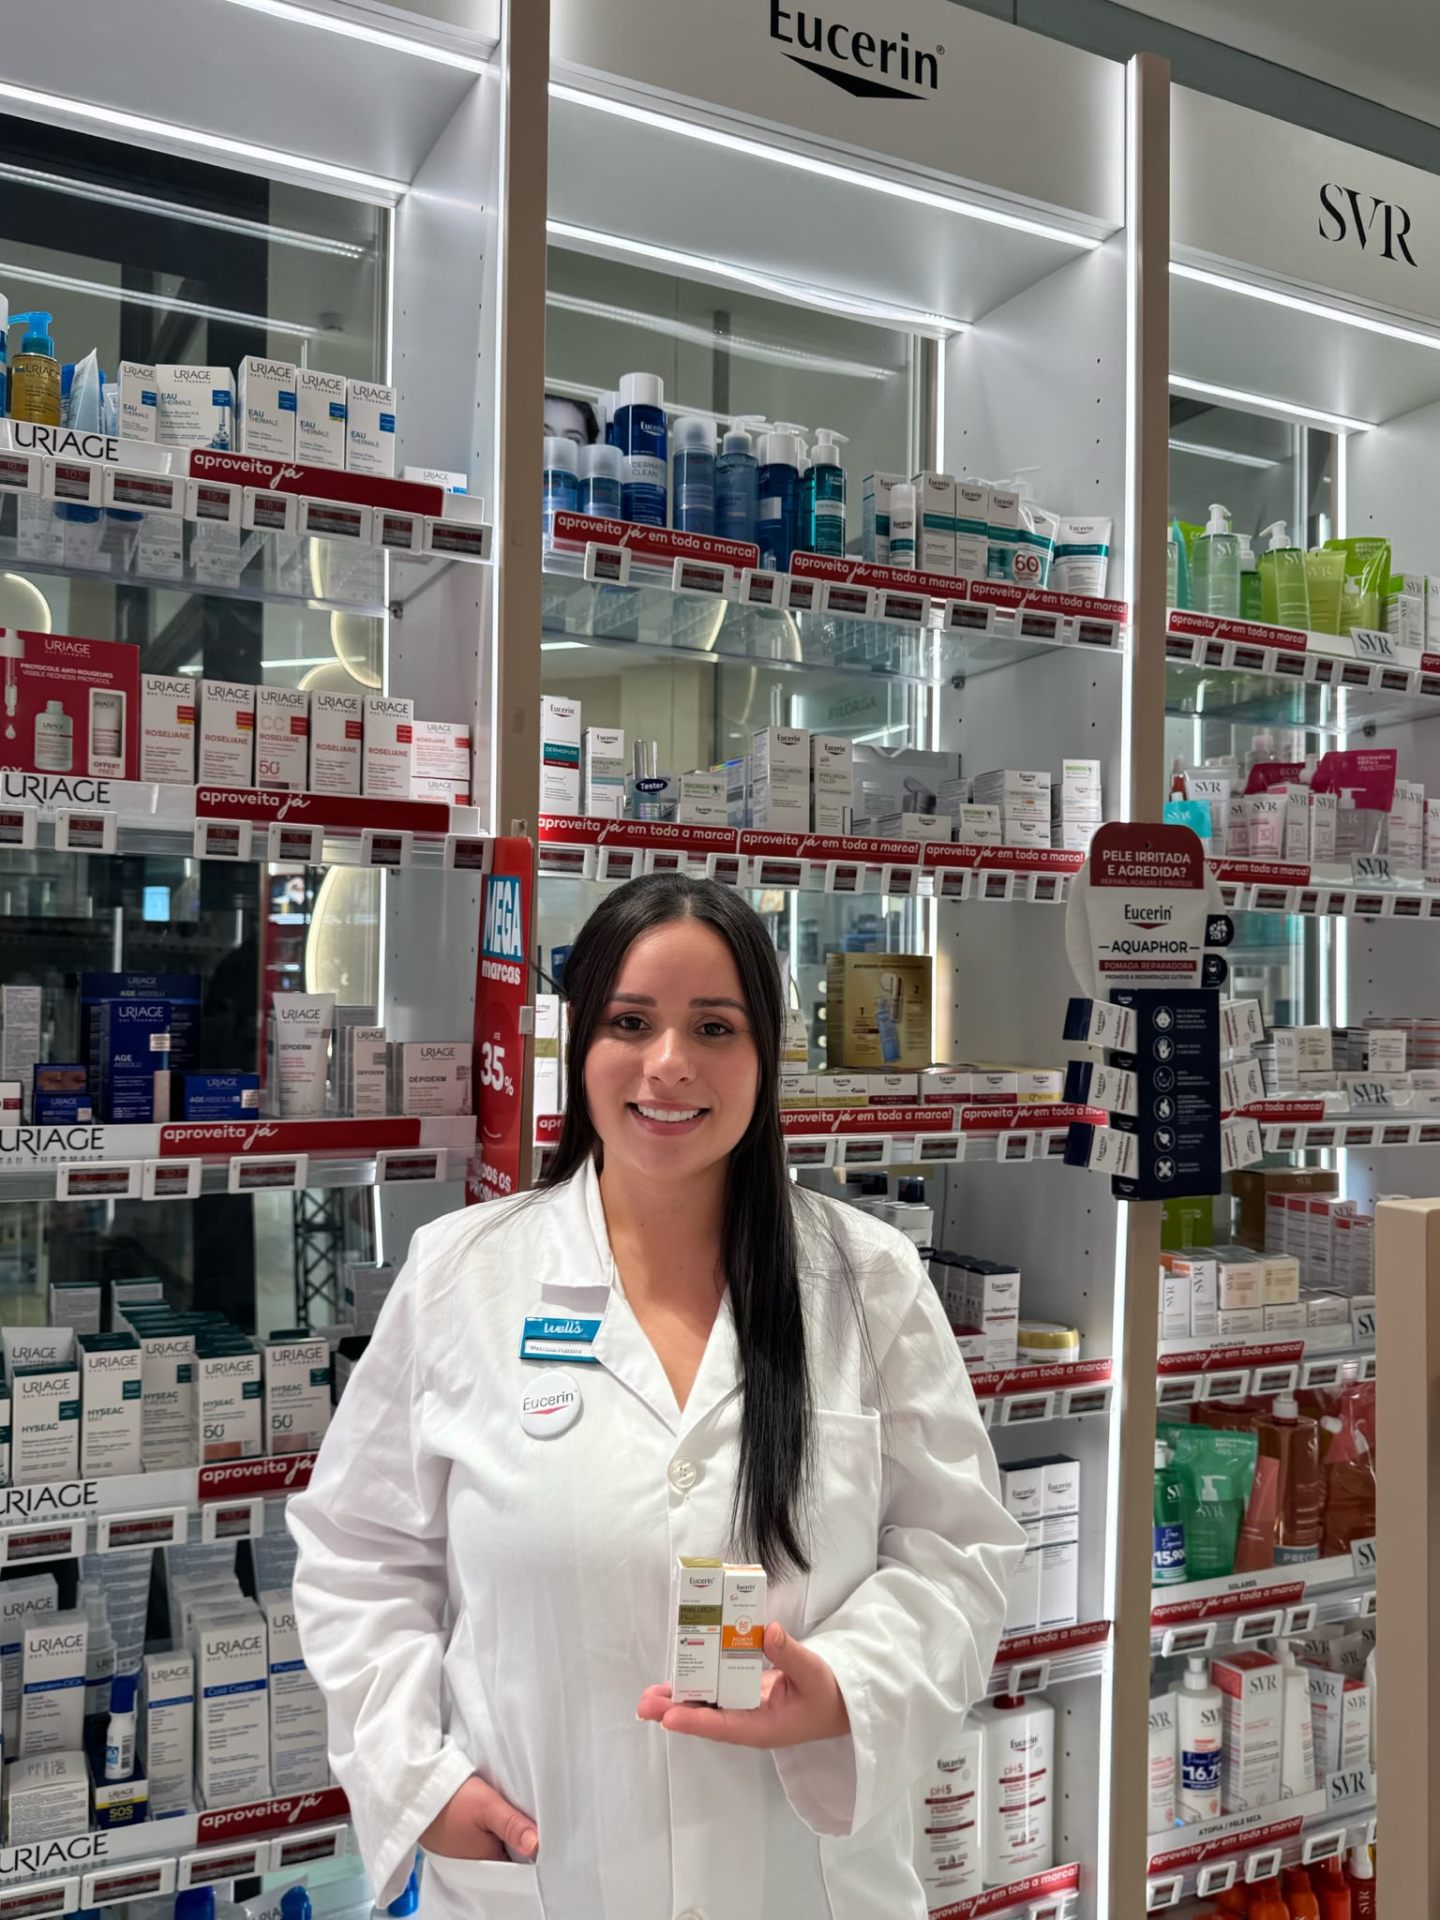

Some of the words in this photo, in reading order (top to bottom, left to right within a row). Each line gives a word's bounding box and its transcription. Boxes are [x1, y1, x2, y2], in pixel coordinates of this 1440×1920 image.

[770, 0, 938, 90] Eucerin
[1319, 183, 1418, 267] SVR
[124, 367, 154, 378] URIAGE
[174, 370, 211, 381] URIAGE
[250, 361, 291, 379] URIAGE
[302, 374, 342, 391] URIAGE
[353, 385, 392, 402] URIAGE
[248, 409, 264, 418] EAU
[300, 420, 316, 429] EAU
[15, 423, 120, 462] URIAGE
[351, 431, 366, 440] EAU
[195, 453, 273, 475] aproveita
[269, 464, 304, 489] já
[558, 516, 622, 535] aproveita
[649, 533, 669, 542] em
[672, 535, 700, 549] toda
[714, 544, 758, 559] marca!
[795, 557, 849, 574] aproveita
[872, 570, 889, 579] em
[892, 571, 916, 584] toda
[919, 579, 926, 587] a
[929, 577, 966, 591] marca!
[973, 584, 1022, 600] aproveita
[1042, 595, 1058, 604] em
[1060, 595, 1082, 608] toda
[1094, 601, 1128, 614] marca!
[45, 640, 91, 654] URIAGE
[1358, 633, 1393, 654] SVR
[147, 680, 191, 694] URIAGE
[208, 685, 251, 700] URIAGE
[261, 692, 305, 706] URIAGE
[318, 695, 358, 710] URIAGE
[370, 700, 409, 714] URIAGE
[550, 704, 575, 715] Eucerin
[260, 715, 286, 730] CC
[145, 729, 191, 740] ROSELIANE
[205, 734, 249, 745] ROSELIANE
[259, 733, 300, 743] ROSELIANE
[777, 734, 801, 743] Eucerin
[316, 743, 357, 754] ROSELIANE
[368, 747, 408, 757] ROSELIANE
[824, 744, 846, 752] Eucerin
[5, 774, 111, 804] URIAGE
[640, 782, 664, 791] Tester
[1195, 781, 1221, 792] SVR
[200, 789, 280, 806] aproveita
[276, 794, 311, 820] já
[1253, 801, 1277, 812] SVR
[1289, 793, 1307, 806] SVR
[1317, 797, 1335, 810] SVR
[539, 818, 600, 832] aproveita
[627, 825, 647, 835] em
[650, 825, 679, 838] toda
[682, 830, 690, 838] a
[693, 830, 736, 842] marca!
[743, 834, 799, 847] aproveita
[822, 840, 839, 848] em
[842, 840, 868, 851] toda
[880, 843, 918, 854] marca!
[927, 844, 976, 858] aproveita
[997, 849, 1013, 857] em
[1015, 849, 1038, 860] toda
[1049, 852, 1084, 863] marca!
[1103, 850, 1132, 862] PELE
[1136, 852, 1191, 864] IRRITADA
[1108, 865, 1115, 875] E
[1118, 866, 1186, 878] AGREDIDA?
[1357, 857, 1390, 876] SVR
[1124, 904, 1172, 920] Eucerin
[483, 881, 522, 958] MEGA
[1111, 941, 1188, 954] AQUAPHOR
[481, 959, 521, 985] marcas
[1105, 962, 1139, 970] POMADA
[1141, 962, 1193, 970] REPARADORA
[119, 1006, 164, 1018] URIAGE
[282, 1009, 320, 1020] URIAGE
[357, 1031, 384, 1040] URIAGE
[421, 1047, 456, 1057] URIAGE
[207, 1079, 237, 1087] URIAGE
[1353, 1084, 1388, 1104] SVR
[857, 1113, 874, 1121] em
[877, 1110, 902, 1121] toda
[915, 1109, 952, 1120] marca!
[164, 1126, 246, 1142] aproveita
[243, 1122, 279, 1150] já
[1193, 1266, 1204, 1293] SVR
[13, 1347, 56, 1360] URIAGE
[146, 1341, 190, 1356] URIAGE
[273, 1347, 323, 1362] URIAGE
[89, 1356, 138, 1370] URIAGE
[204, 1361, 254, 1374] URIAGE
[23, 1379, 70, 1394] URIAGE
[271, 1384, 303, 1392] HYSEAC
[144, 1391, 178, 1400] HYSEAC
[523, 1391, 574, 1411] Eucerin
[204, 1399, 234, 1407] HYSEAC
[88, 1407, 124, 1416] HYSEAC
[22, 1423, 58, 1433] HYSEAC
[202, 1461, 287, 1483] aproveita
[284, 1456, 315, 1484] já
[689, 1577, 713, 1585] Eucerin
[1229, 1580, 1257, 1590] SOLARES
[4, 1597, 53, 1617] URIAGE
[1013, 1637, 1030, 1648] em
[1032, 1631, 1057, 1644] toda
[1061, 1630, 1068, 1638] a
[1070, 1623, 1109, 1637] marca!
[30, 1635, 83, 1653] URIAGE
[207, 1636, 261, 1656] URIAGE
[1304, 1640, 1330, 1655] SVR
[1340, 1650, 1360, 1664] SVR
[152, 1666, 190, 1680] URIAGE
[207, 1688, 228, 1697] Cold
[230, 1684, 256, 1694] Cream
[1250, 1674, 1277, 1693] SVR
[1310, 1680, 1336, 1695] SVR
[1348, 1695, 1366, 1710] SVR
[937, 1757, 965, 1769] Eucerin
[1332, 1771, 1366, 1799] SVR
[108, 1788, 134, 1798] URIAGE
[109, 1806, 133, 1819] SOS
[202, 1800, 291, 1827] aproveita
[288, 1794, 323, 1823] já
[1199, 1824, 1223, 1836] ATOPIA
[1230, 1819, 1245, 1829] PELE
[1247, 1814, 1262, 1824] SECA
